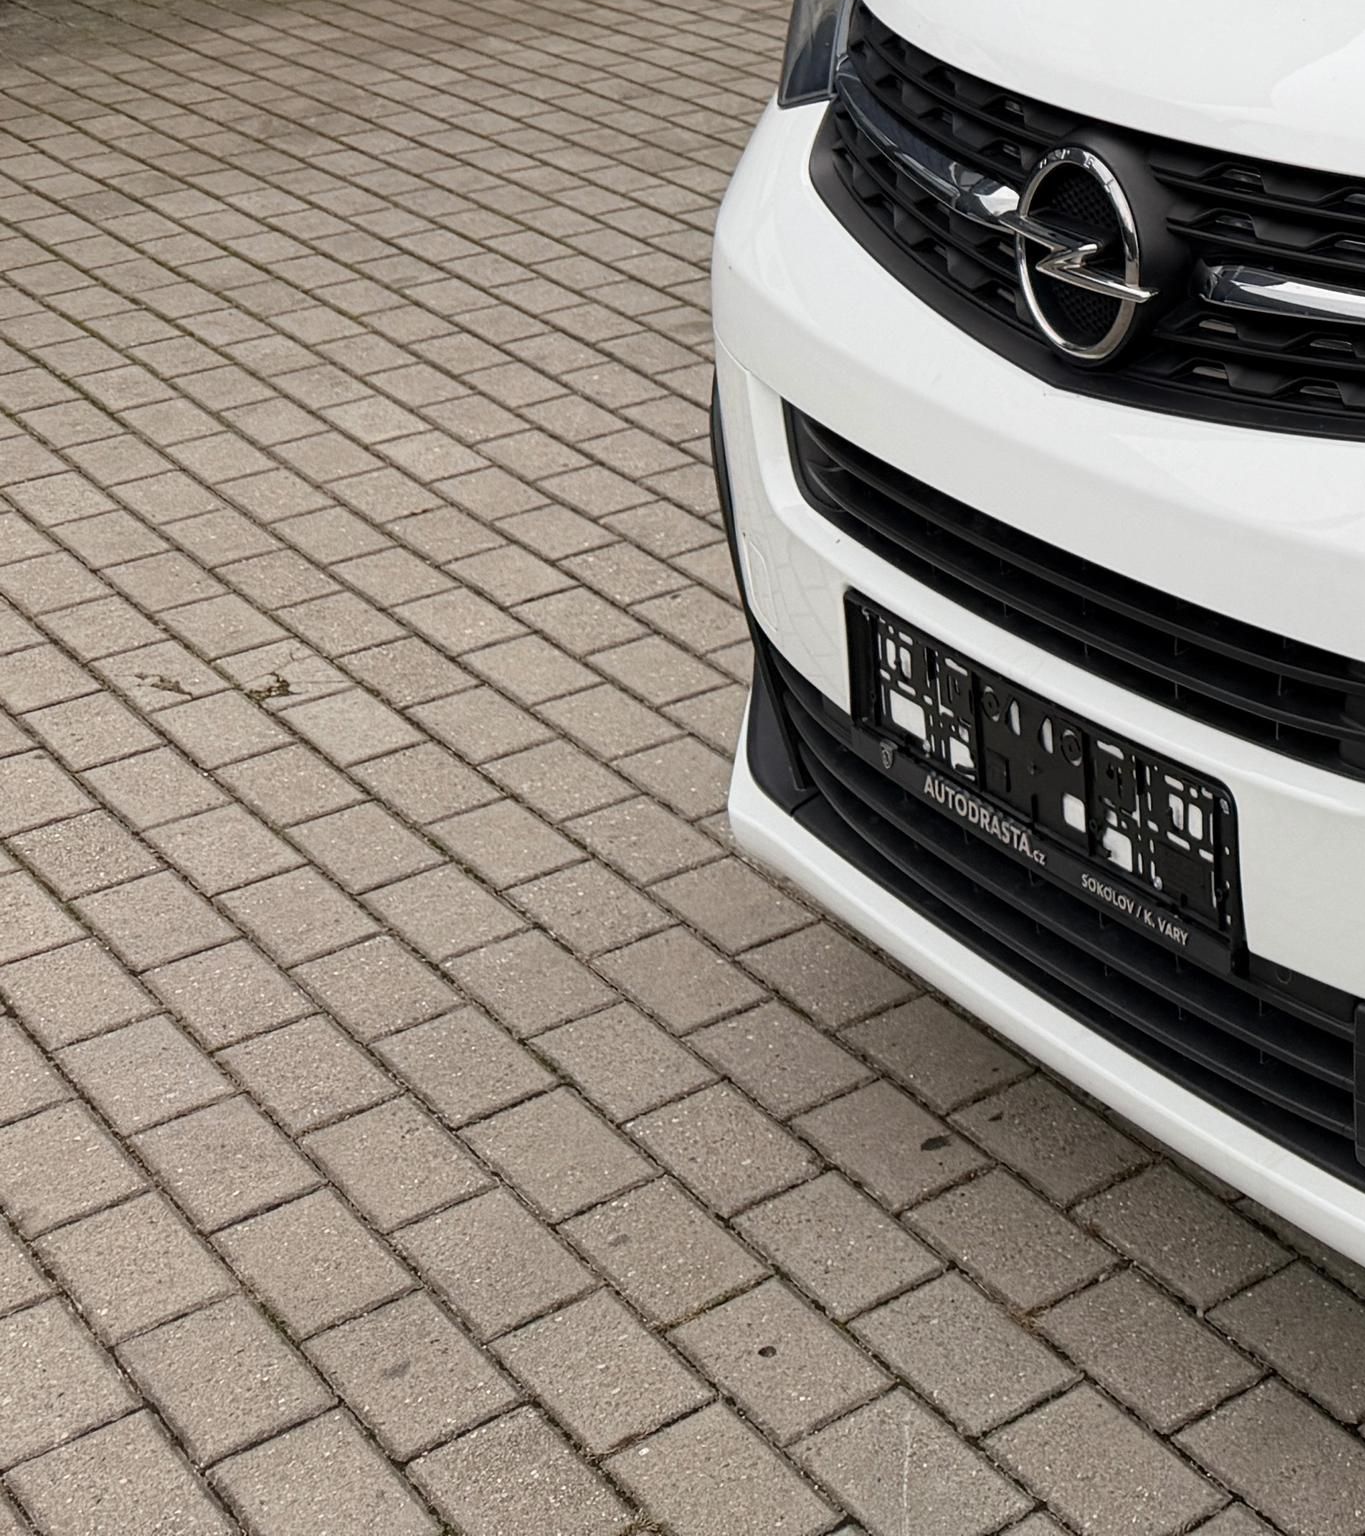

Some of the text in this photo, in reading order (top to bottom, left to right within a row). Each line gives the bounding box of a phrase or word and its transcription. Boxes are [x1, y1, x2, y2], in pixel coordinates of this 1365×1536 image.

[1080, 873, 1135, 915] SOKOLOV
[1143, 910, 1156, 929] K.
[1157, 918, 1190, 947] VARY
